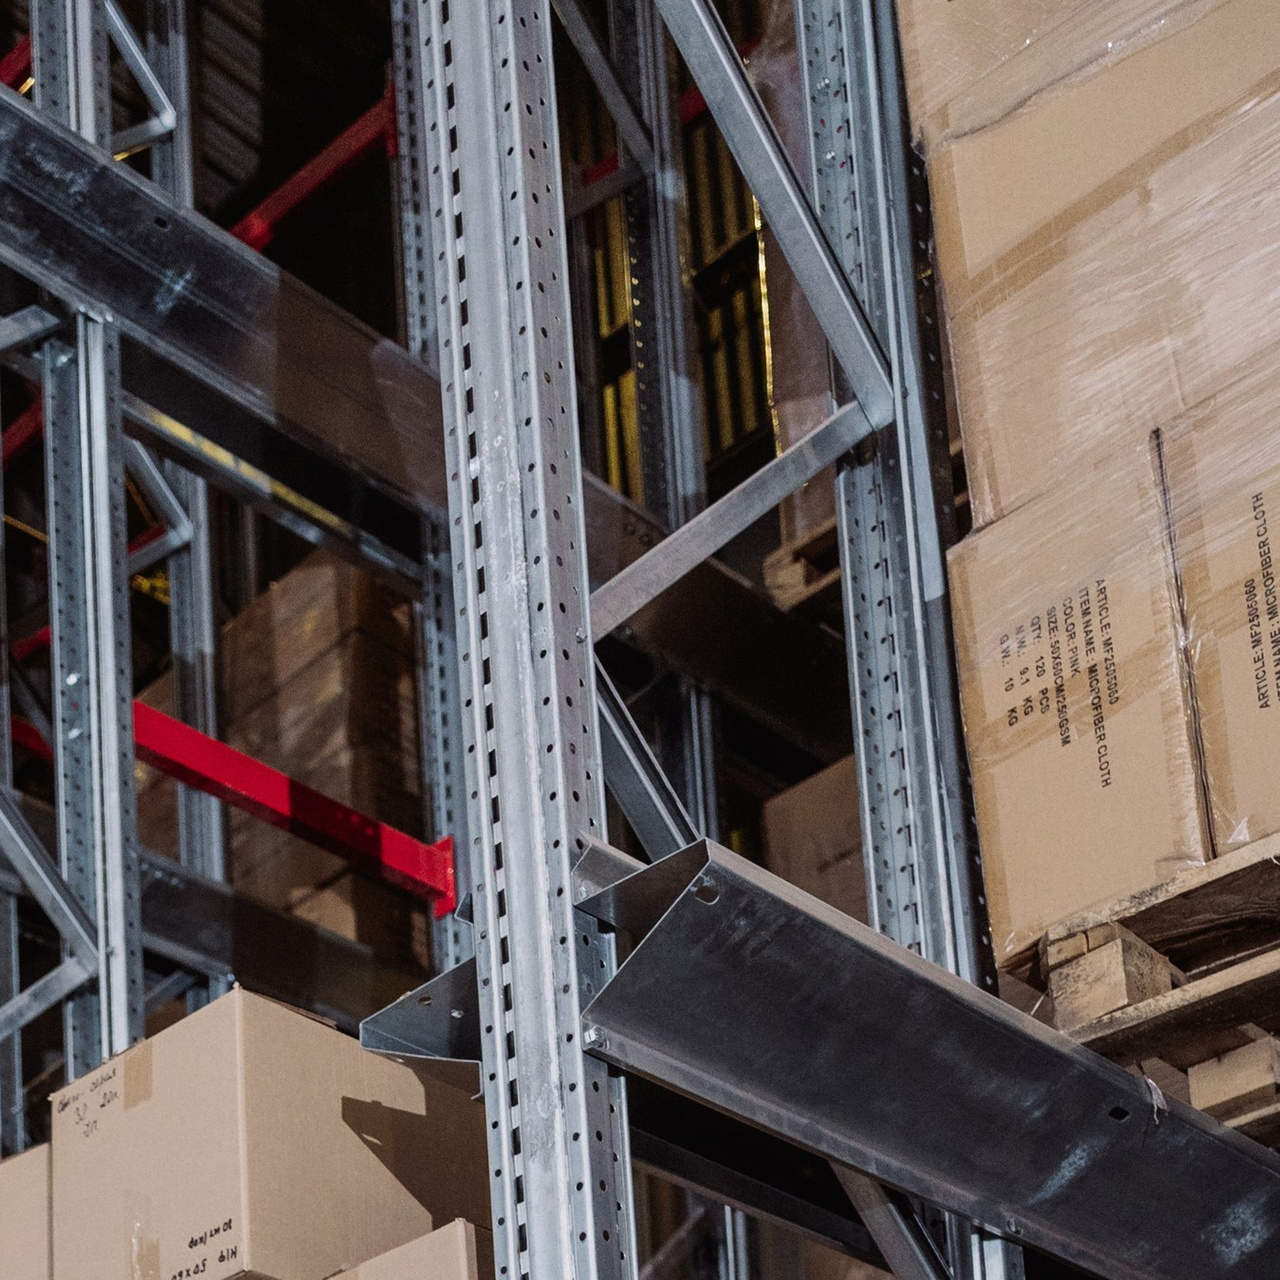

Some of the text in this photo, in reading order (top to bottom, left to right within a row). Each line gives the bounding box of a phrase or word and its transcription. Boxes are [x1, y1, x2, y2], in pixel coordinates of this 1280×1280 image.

[1251, 492, 1268, 538] CLOTH
[1030, 616, 1050, 714] QTY: 120 PCS
[1046, 606, 1059, 640] SIZE:
[1062, 597, 1081, 678] COLOR: PINK
[1095, 579, 1119, 705] ARTICLE: MF2505060
[1244, 578, 1271, 709] ARTICLE: MF2505060
[999, 634, 1019, 727] GW.: 10 KG
[1020, 666, 1030, 686] 9.1
[1022, 695, 1034, 716] KG
[1079, 586, 1091, 619] ITEM
[1097, 744, 1112, 788] CLOTH
